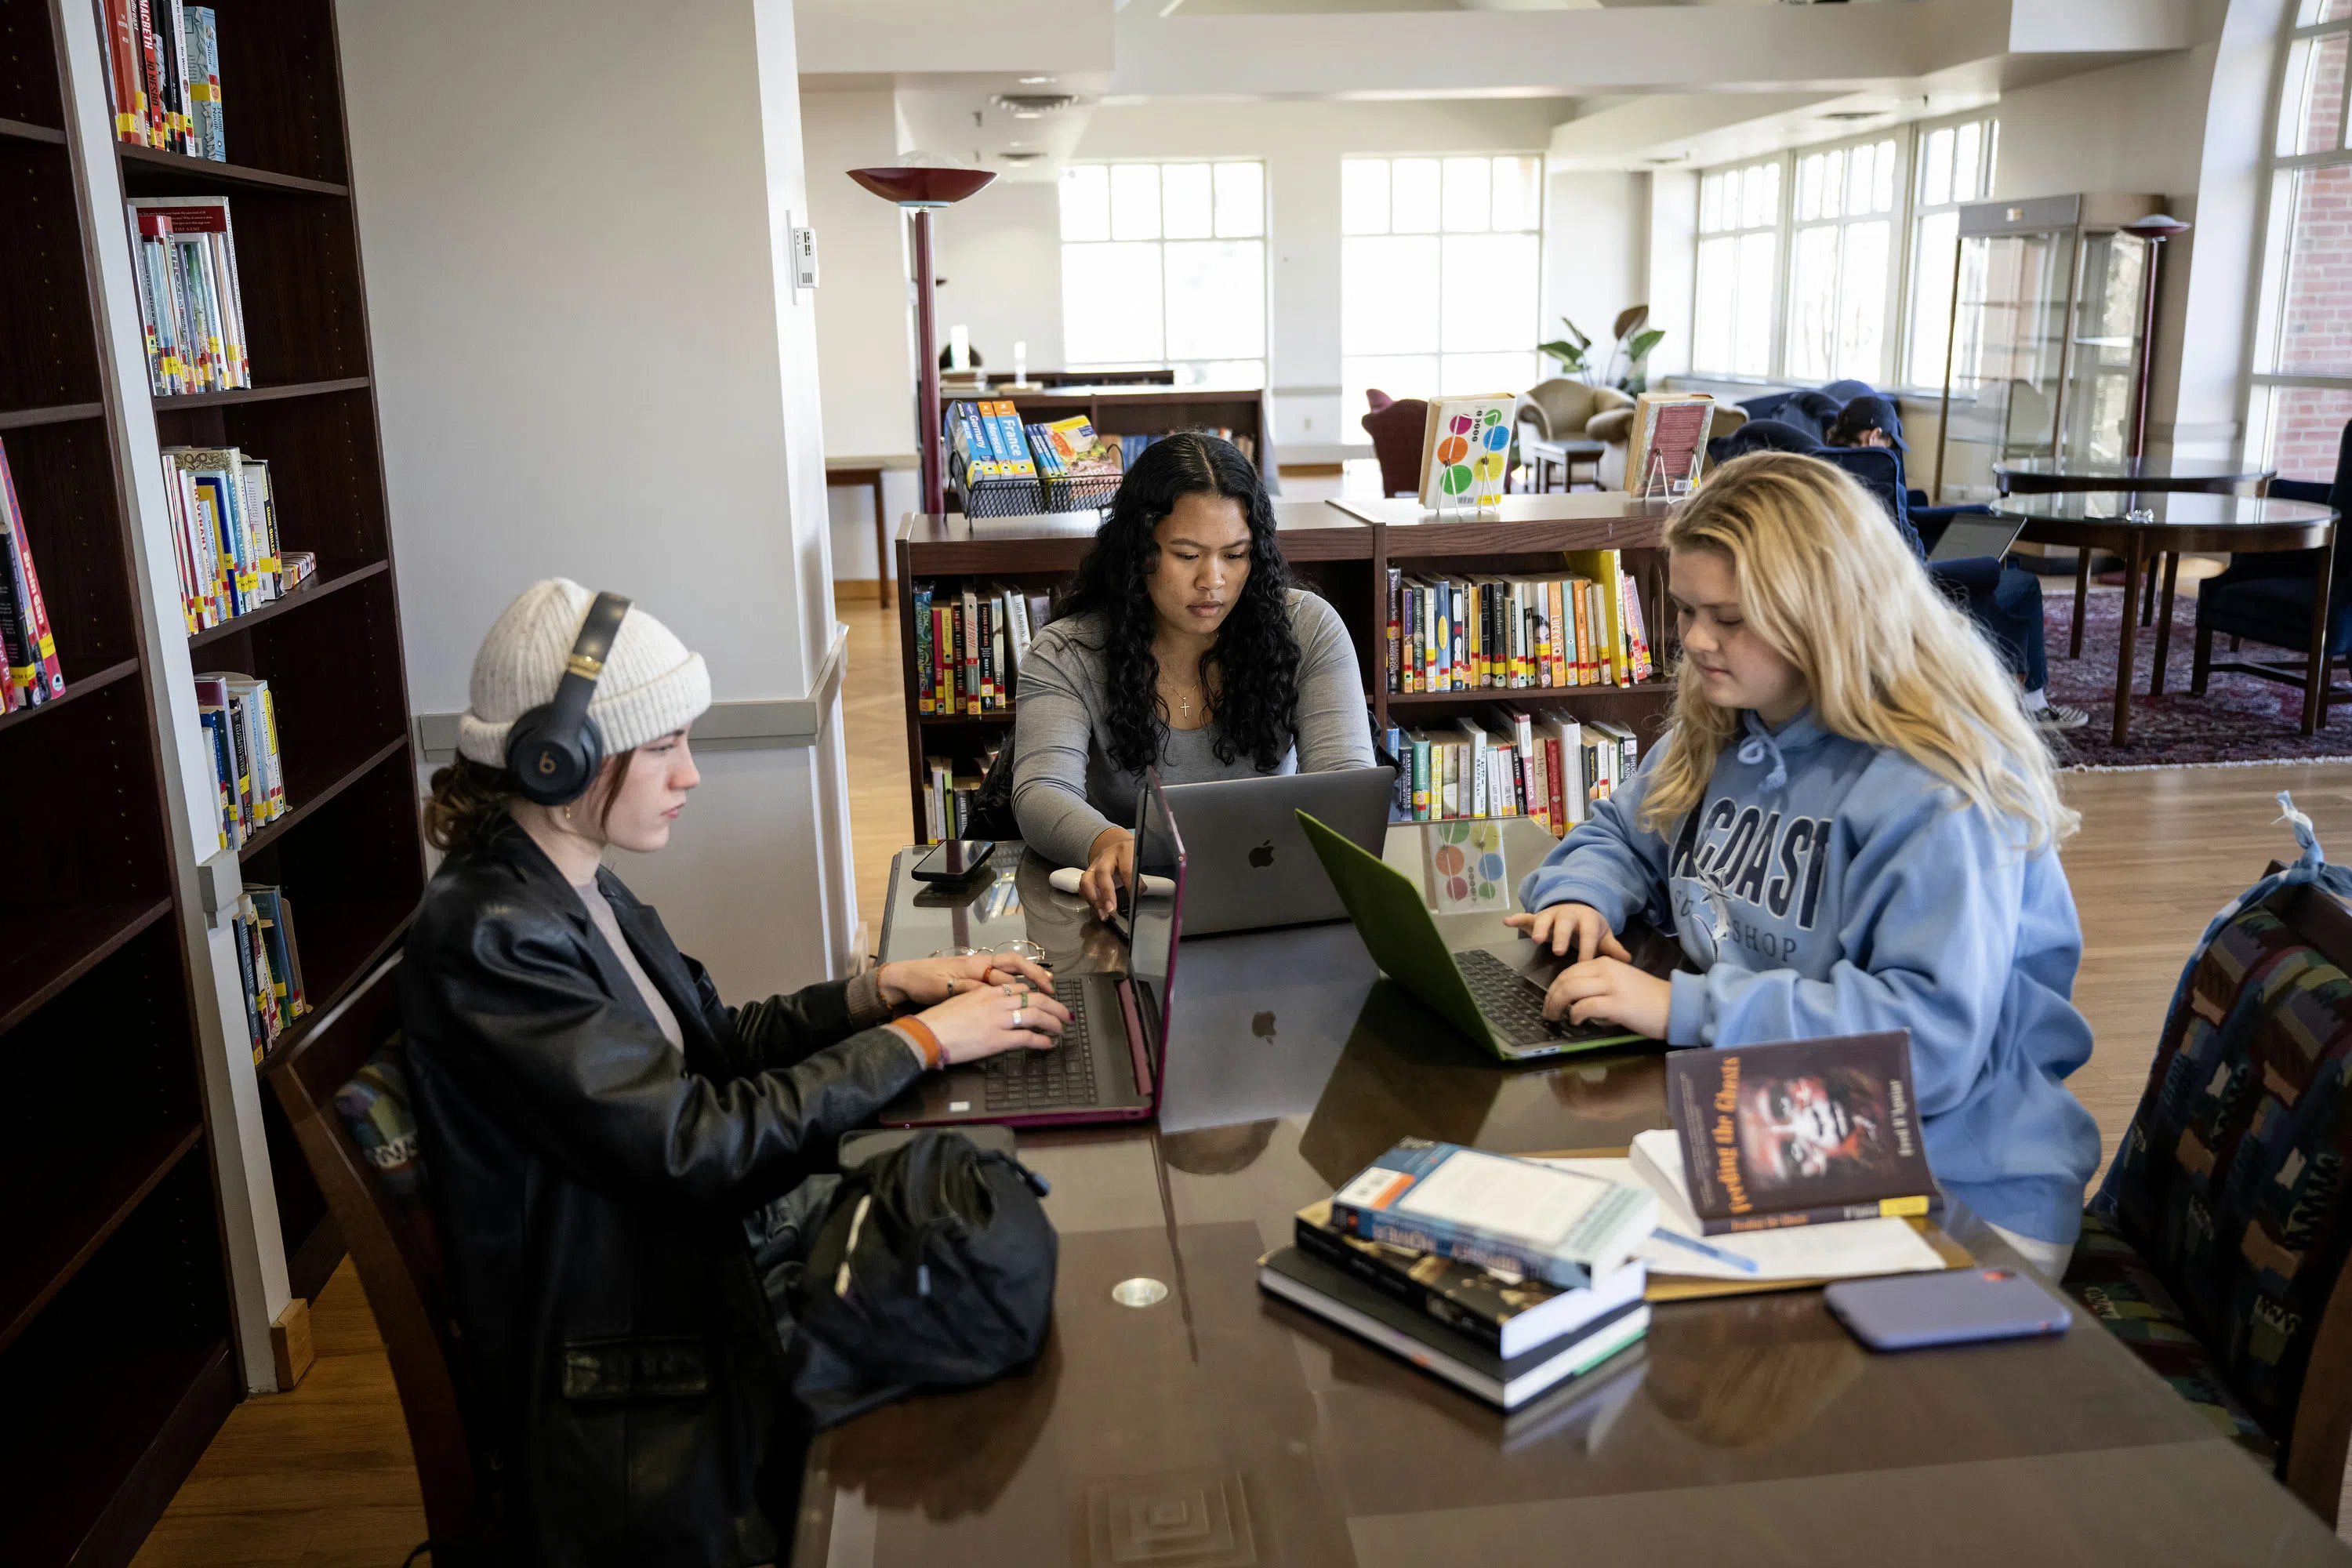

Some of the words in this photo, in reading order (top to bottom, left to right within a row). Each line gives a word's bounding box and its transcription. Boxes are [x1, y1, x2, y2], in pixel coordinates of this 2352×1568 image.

[139, 0, 153, 49] MACBETH
[147, 57, 155, 71] JO
[168, 235, 179, 269] RUTH
[962, 421, 973, 439] BELIZE
[969, 415, 986, 449] Germany
[987, 423, 1004, 455] Morocco
[1003, 419, 1022, 457] France
[23, 551, 36, 594] Brain
[1550, 615, 1562, 640] LUCKY
[3, 666, 11, 681] Pi
[1526, 762, 1534, 800] AMERICA
[1732, 920, 1797, 962] SHOP
[1715, 1056, 1740, 1113] Ghosts
[1712, 1114, 1734, 1145] the
[1716, 1147, 1753, 1214] Feeding
